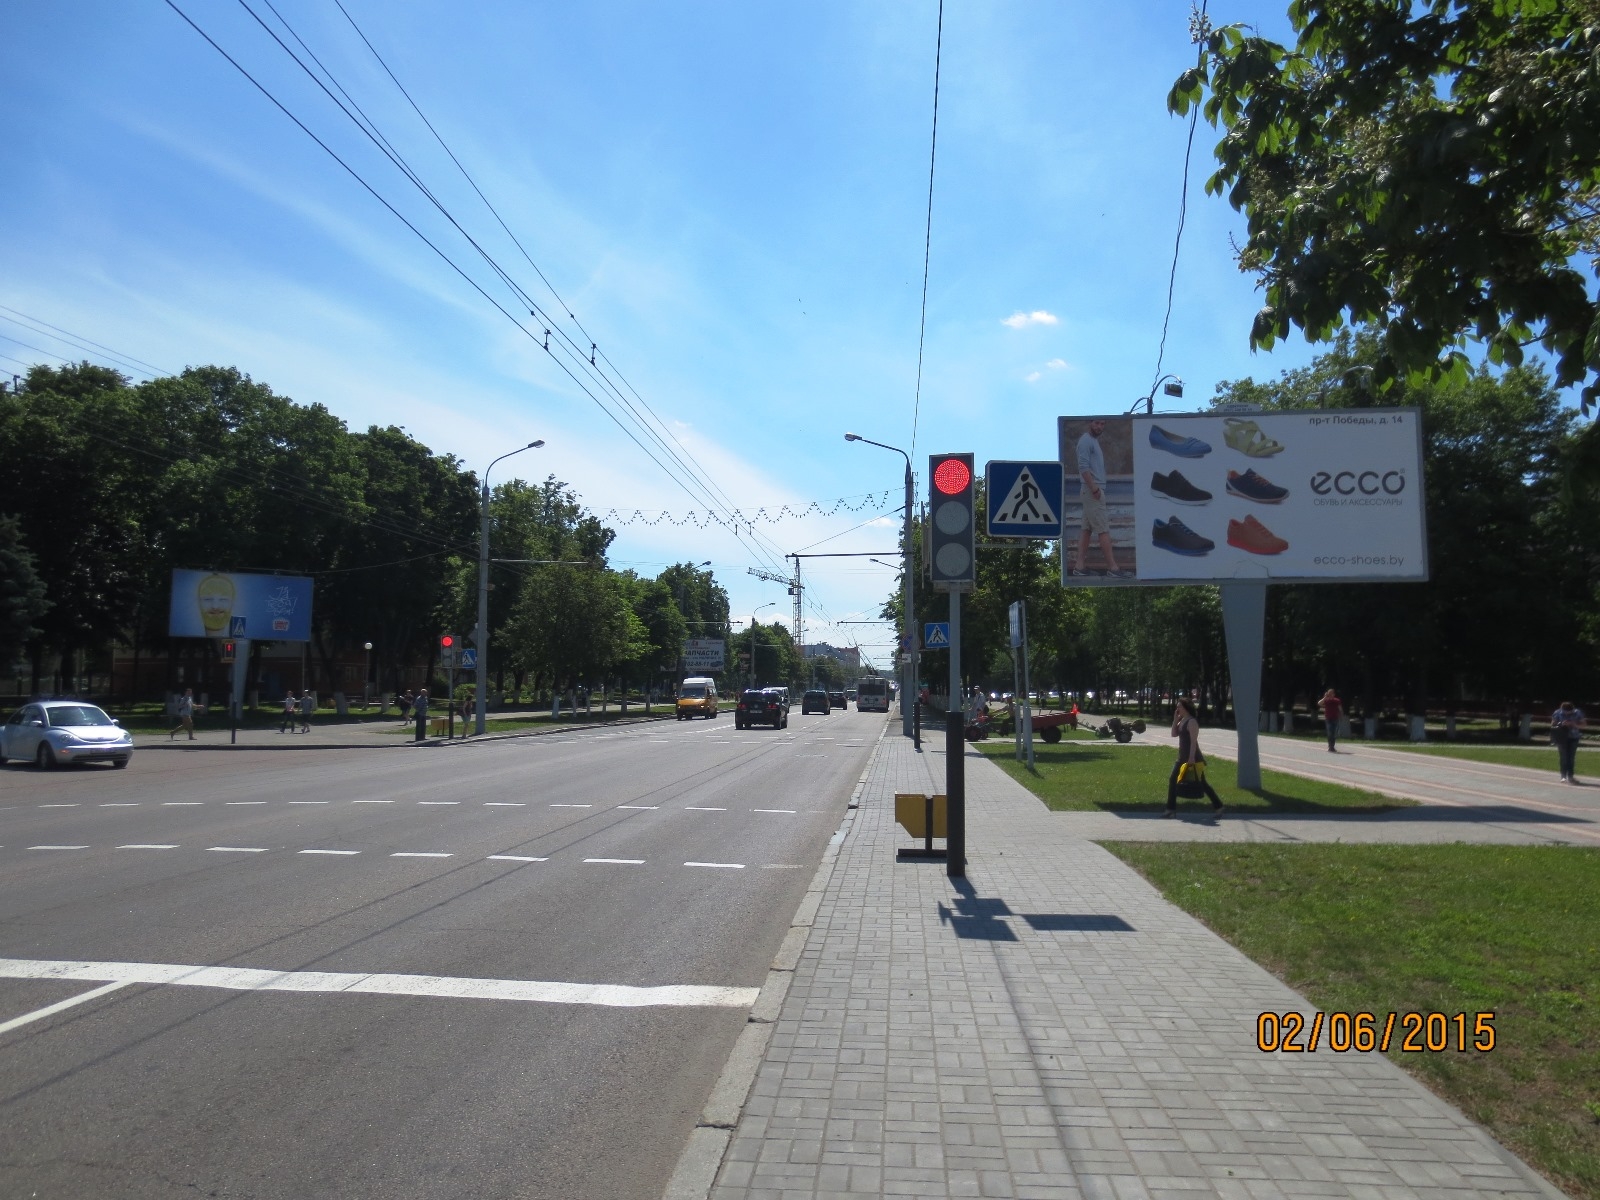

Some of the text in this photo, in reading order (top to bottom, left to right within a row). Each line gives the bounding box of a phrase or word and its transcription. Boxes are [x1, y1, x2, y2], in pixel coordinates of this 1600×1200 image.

[1309, 415, 1403, 425] пр-т Победы, д. 14
[1310, 471, 1405, 495] ecco
[1313, 498, 1403, 506] ОБУВЬ И АКСЕССУАРЫ
[1313, 554, 1404, 567] ecco-shoes.by
